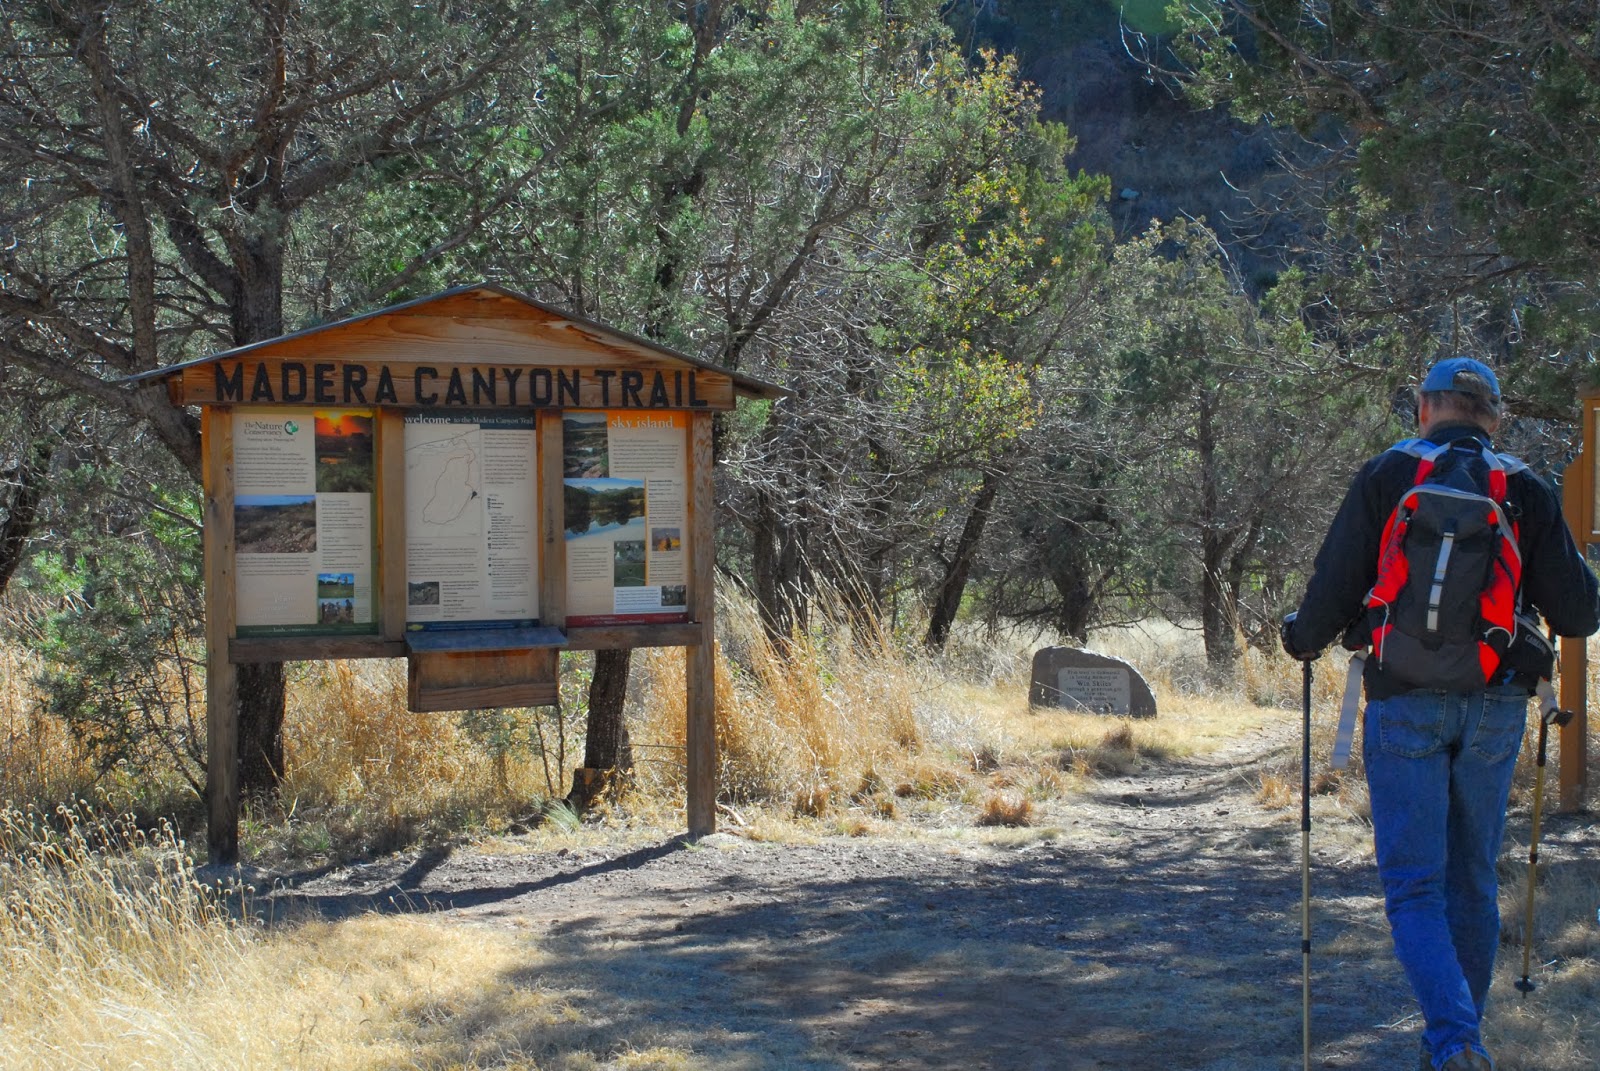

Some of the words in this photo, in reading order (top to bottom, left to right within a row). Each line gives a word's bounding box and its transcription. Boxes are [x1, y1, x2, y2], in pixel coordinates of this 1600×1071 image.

[214, 362, 398, 404] MADERA
[413, 366, 581, 406] CANYON
[594, 369, 708, 407] TRAIL
[404, 414, 451, 424] welcome
[473, 416, 495, 424] Madera
[496, 417, 519, 425] Canyon
[611, 415, 633, 430] sky
[637, 415, 673, 429] island
[254, 421, 283, 430] Nature
[244, 428, 283, 436] Conservancy
